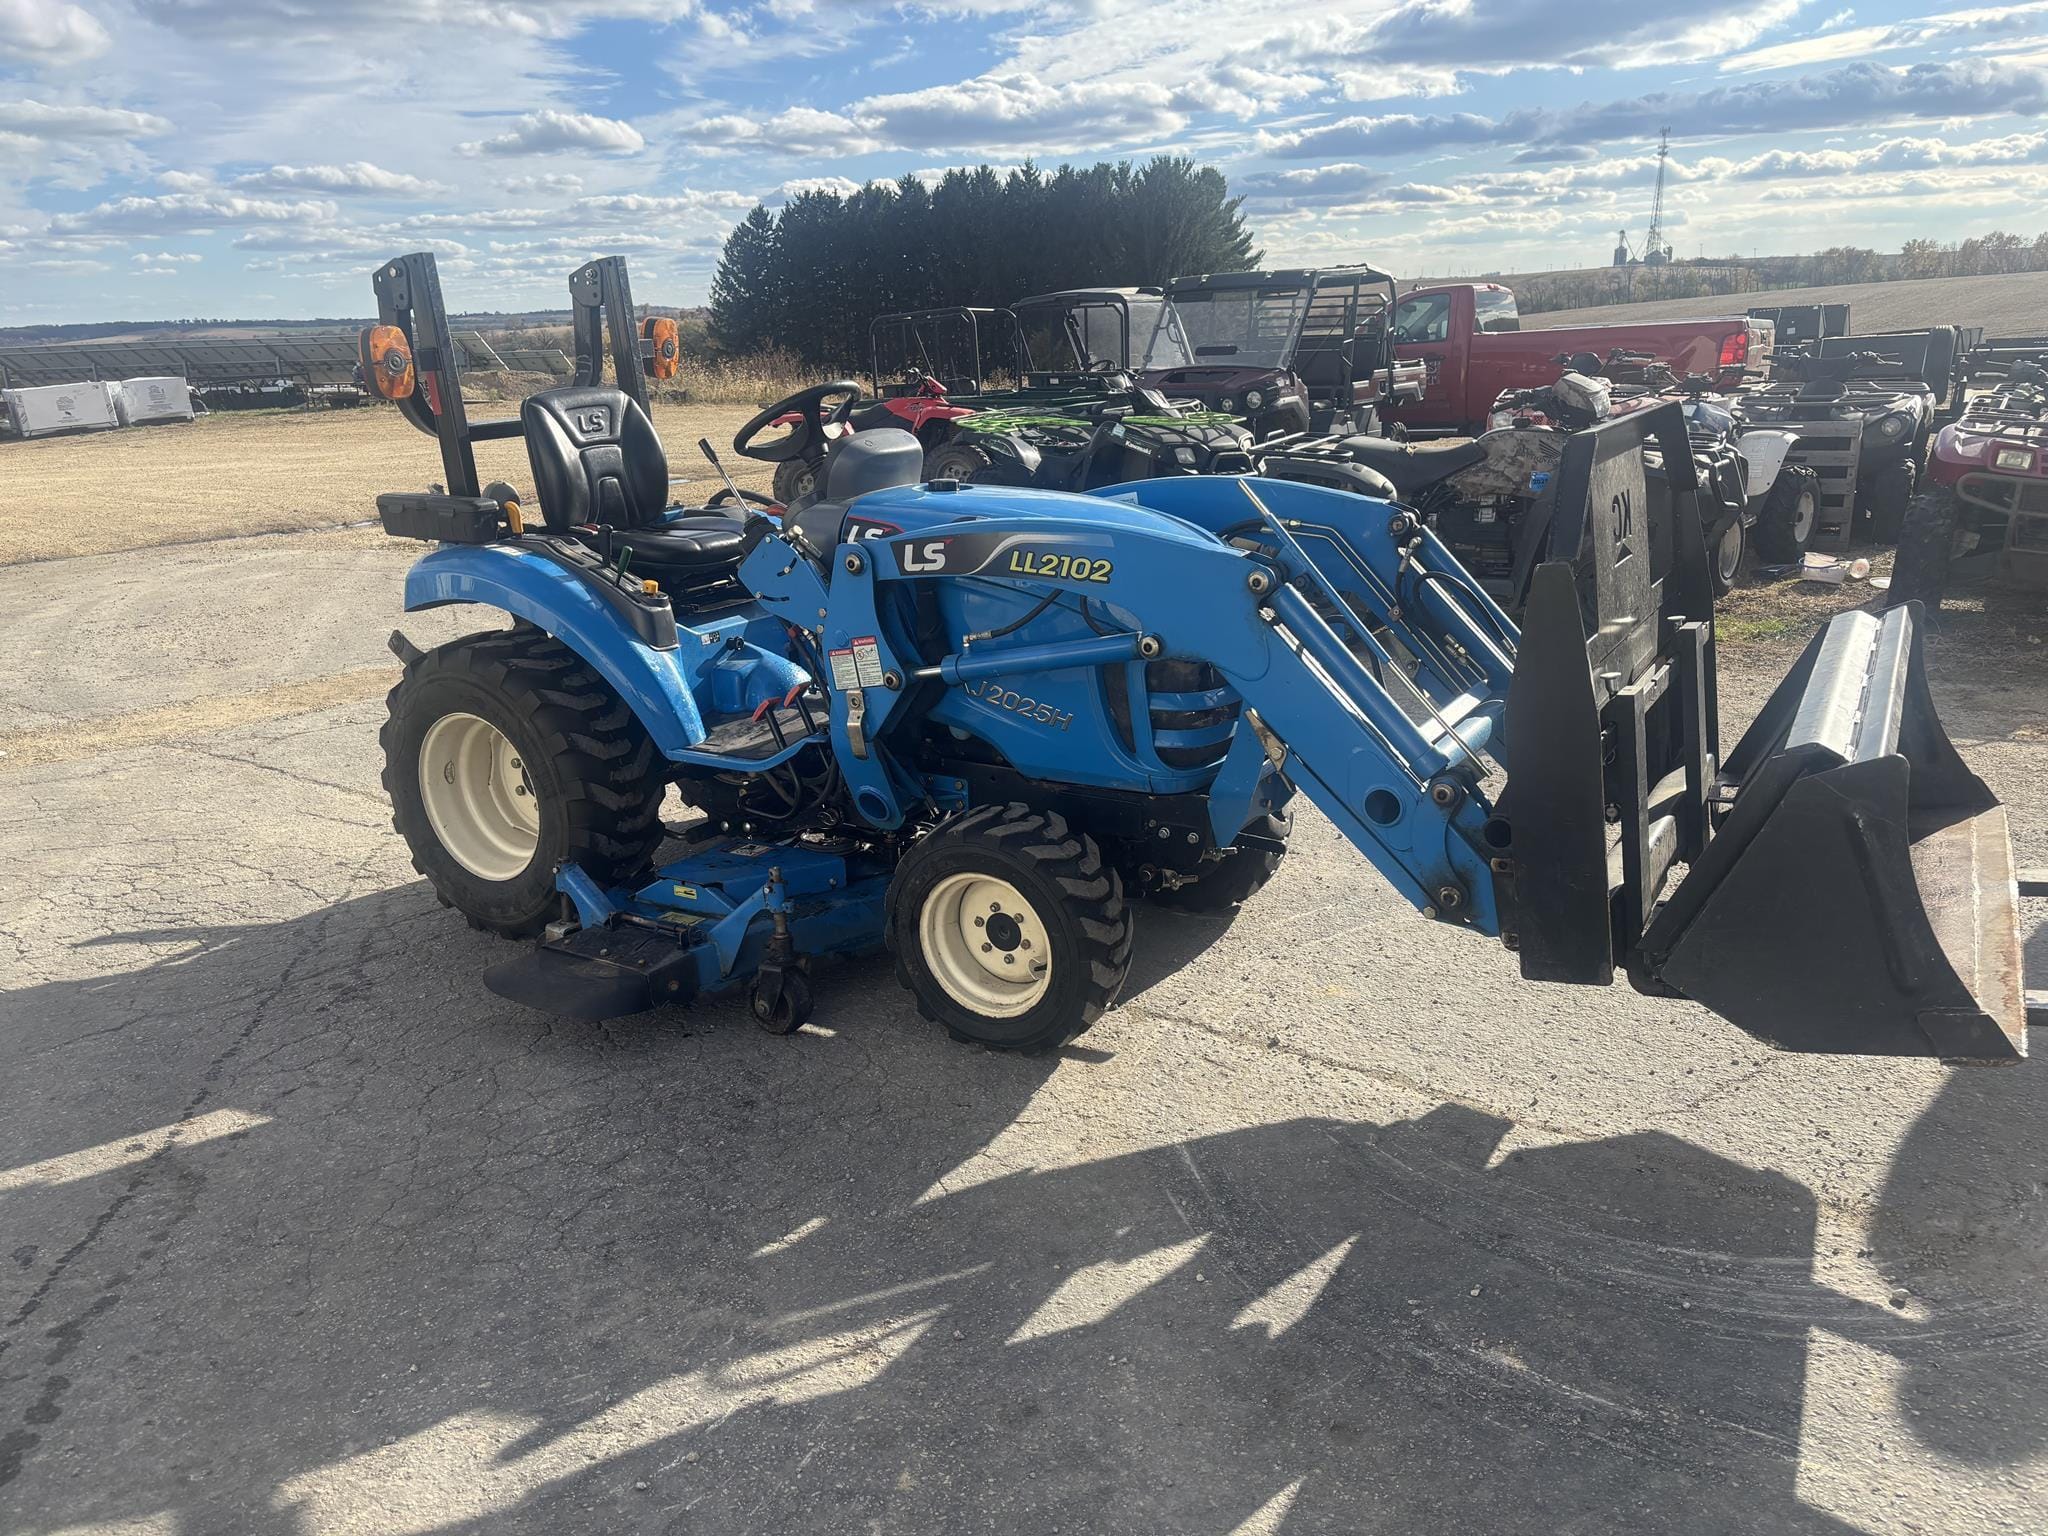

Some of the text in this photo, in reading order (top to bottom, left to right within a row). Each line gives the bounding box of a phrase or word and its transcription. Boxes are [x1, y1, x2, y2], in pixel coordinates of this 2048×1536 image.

[578, 413, 605, 434] LS
[904, 542, 946, 572] LS
[1009, 550, 1111, 582] LL2102
[964, 680, 1074, 732] J2025H
